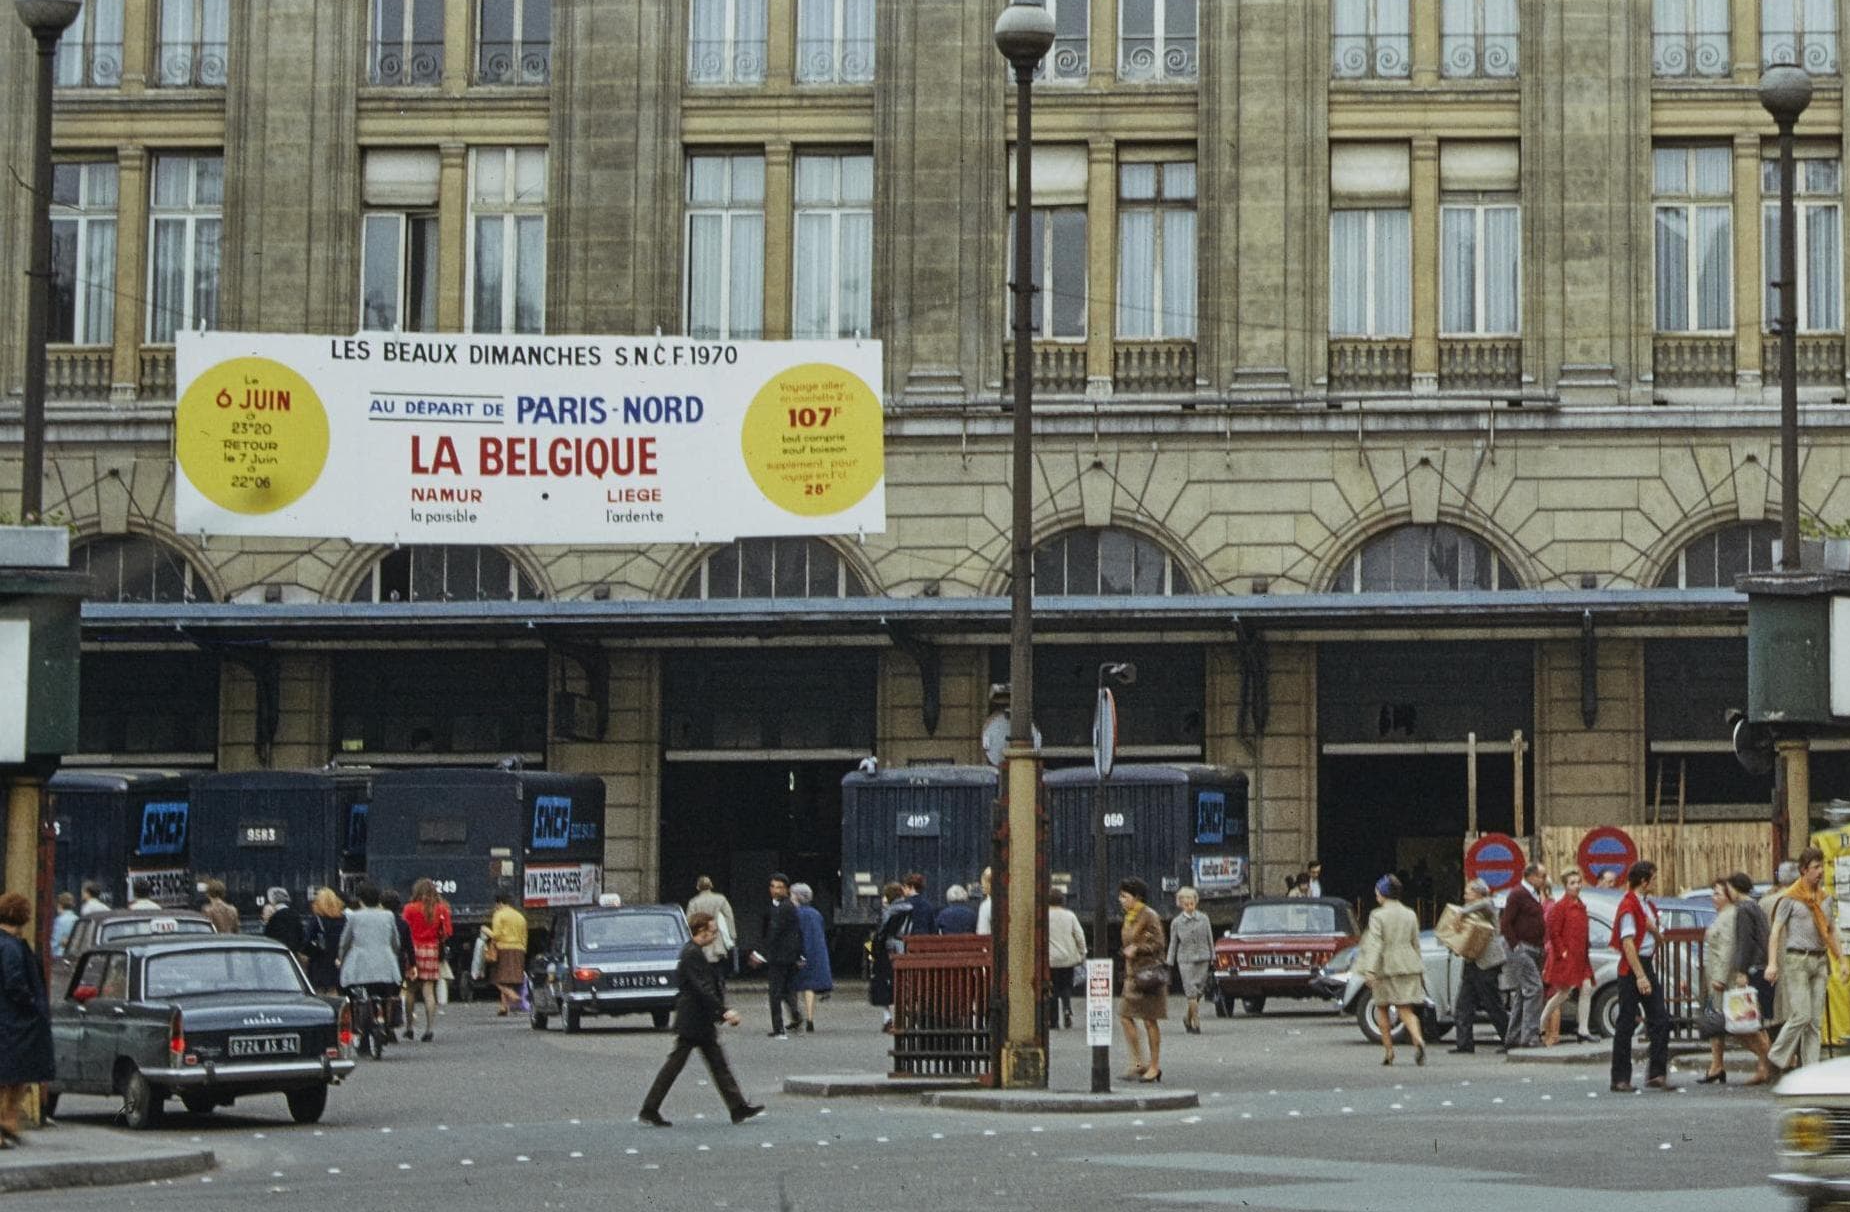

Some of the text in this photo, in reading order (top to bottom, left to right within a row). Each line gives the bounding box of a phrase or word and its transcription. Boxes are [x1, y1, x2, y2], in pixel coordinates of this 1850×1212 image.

[331, 340, 370, 361] LES
[383, 343, 457, 364] BEAUX
[470, 344, 601, 366] DIMANCHES
[216, 388, 290, 410] 6 JUIN
[369, 399, 395, 415] AU
[483, 402, 504, 417] DE
[224, 440, 278, 451] RETOUR
[782, 434, 846, 445] tout compris
[411, 435, 657, 480] LA BELGIQUE
[782, 445, 847, 454] sauf boisson
[224, 453, 278, 464] le 7 Juin
[411, 488, 482, 503] NAMUR
[607, 489, 662, 503] LIEGE
[411, 509, 477, 525] la paisible
[606, 509, 664, 524] l'ardente
[146, 811, 186, 841] SNCF
[536, 802, 570, 840] SNCF
[526, 870, 581, 894] VIN DES ROCHERS
